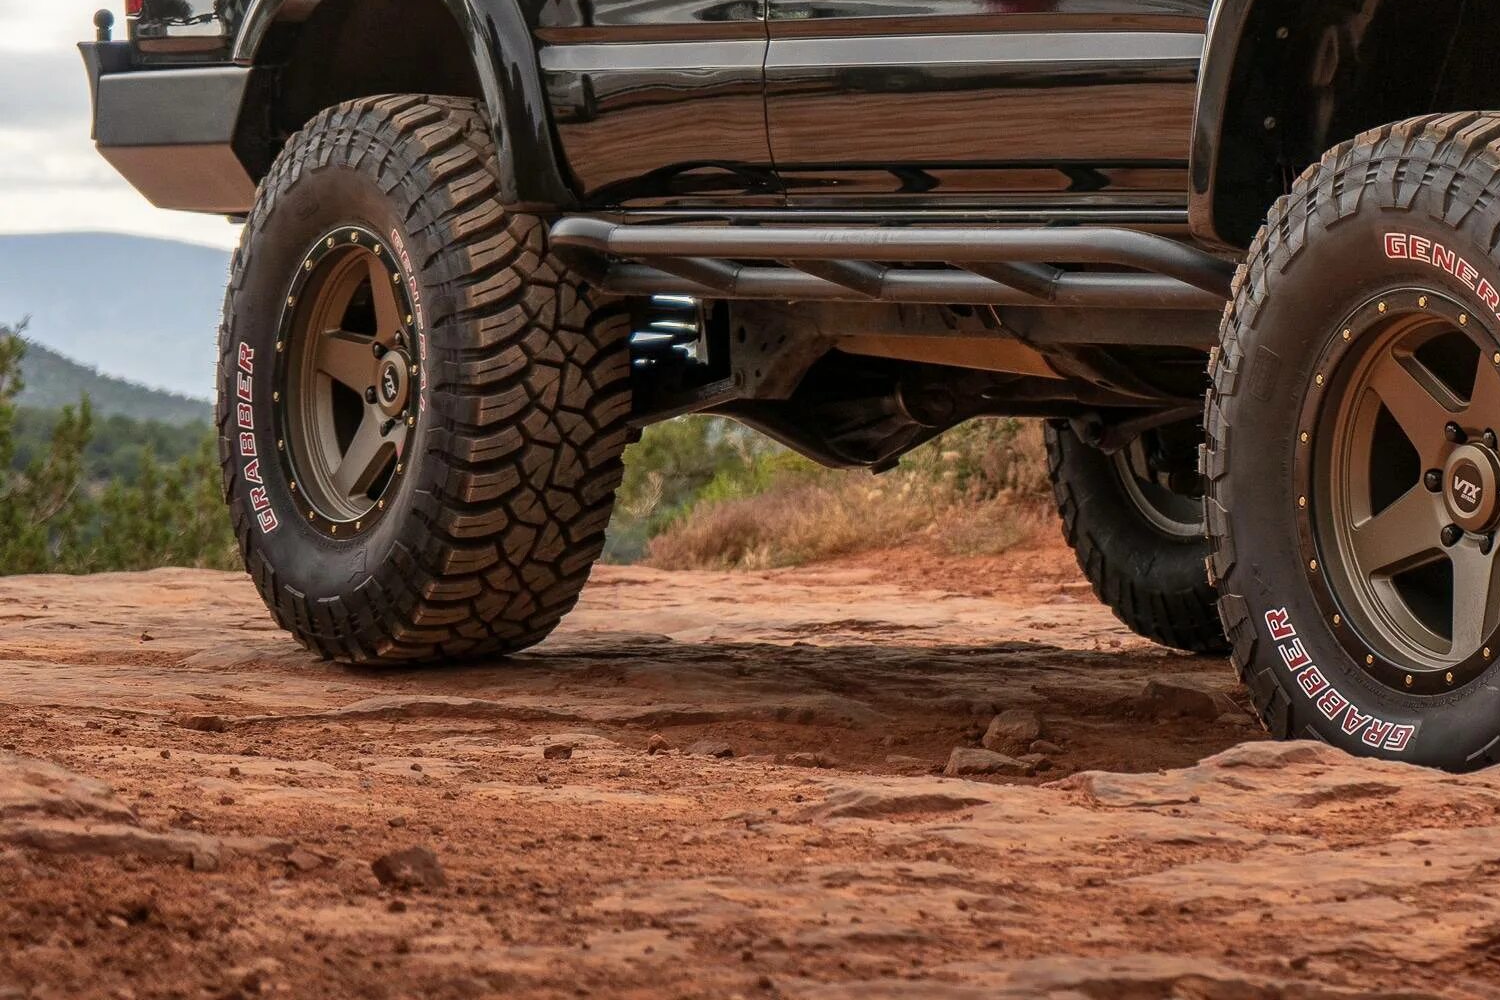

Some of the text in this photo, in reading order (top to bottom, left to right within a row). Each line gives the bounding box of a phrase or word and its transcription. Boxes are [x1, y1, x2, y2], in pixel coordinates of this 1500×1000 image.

[237, 341, 278, 533] GRABBER
[1454, 475, 1481, 499] VTX
[1265, 607, 1415, 751] GRABBER
